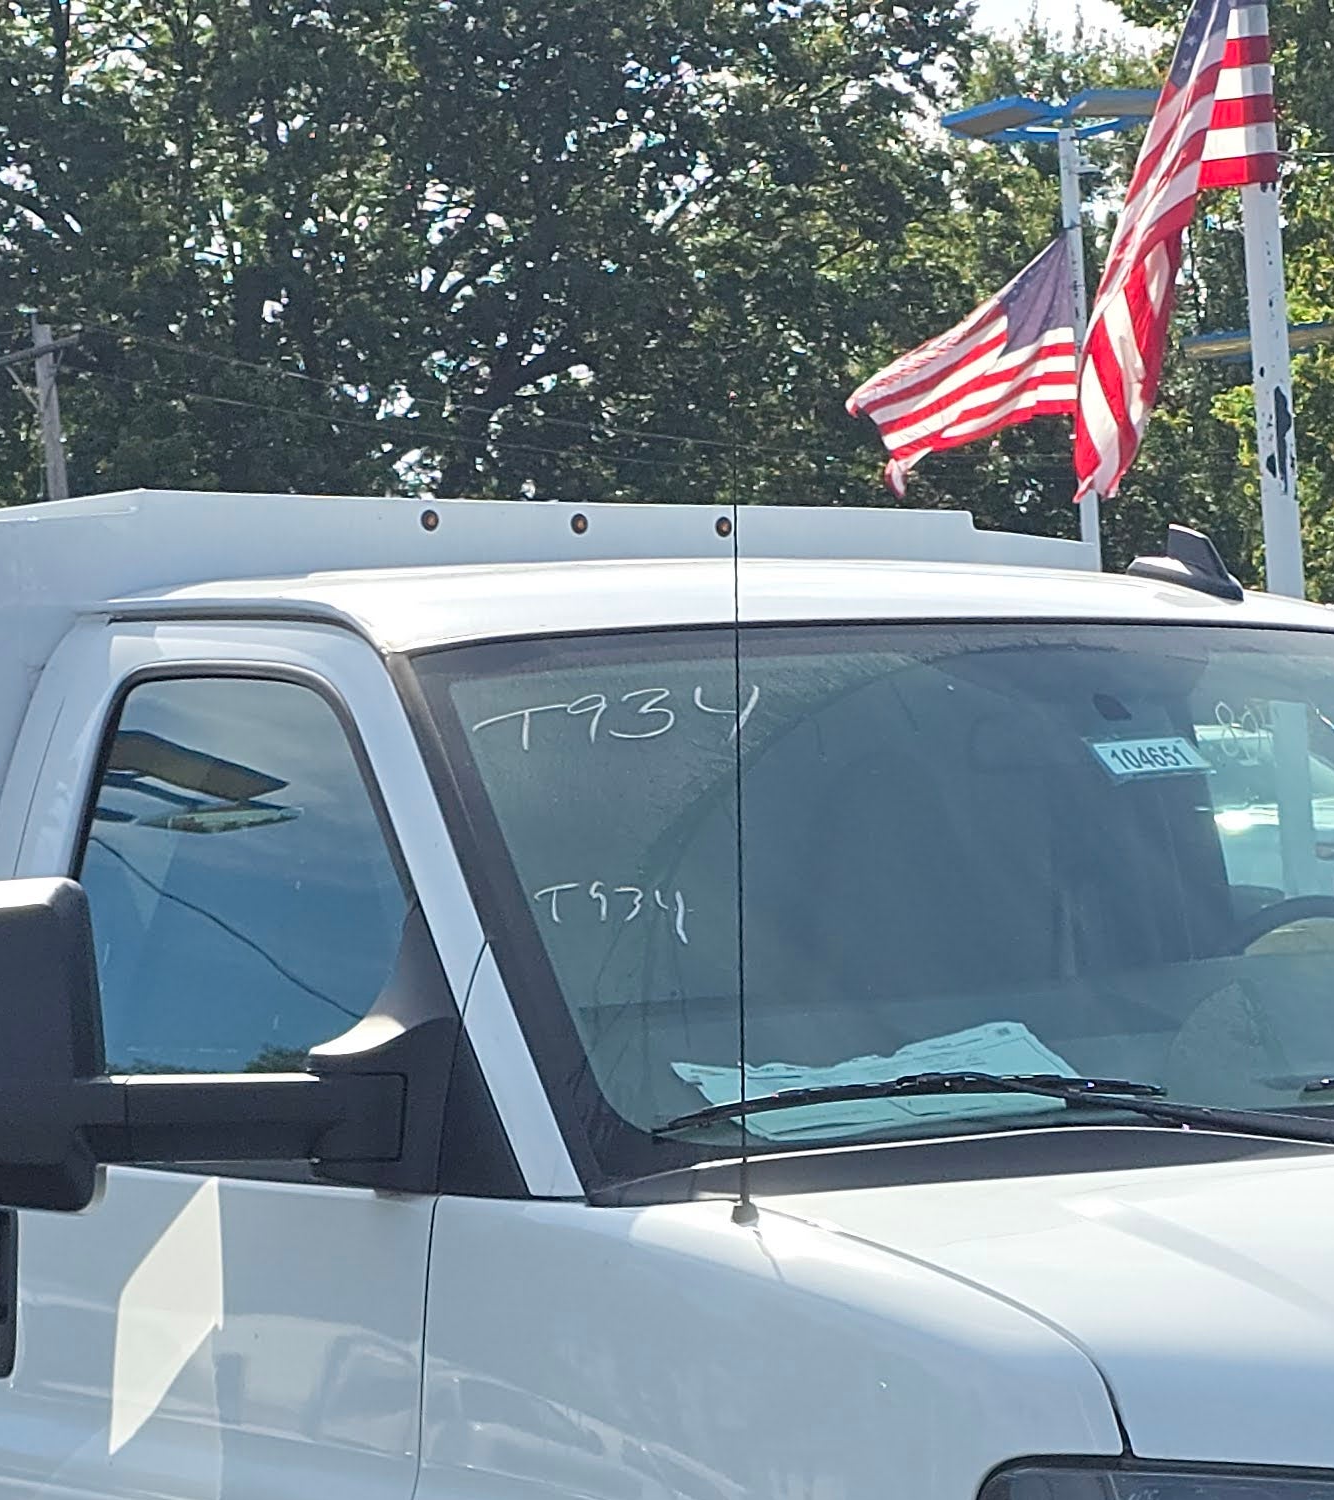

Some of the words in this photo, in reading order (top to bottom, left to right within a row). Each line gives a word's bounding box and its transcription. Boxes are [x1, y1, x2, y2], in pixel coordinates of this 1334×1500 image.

[472, 685, 760, 751] T934
[1110, 744, 1193, 770] 104651
[533, 880, 694, 944] T934
